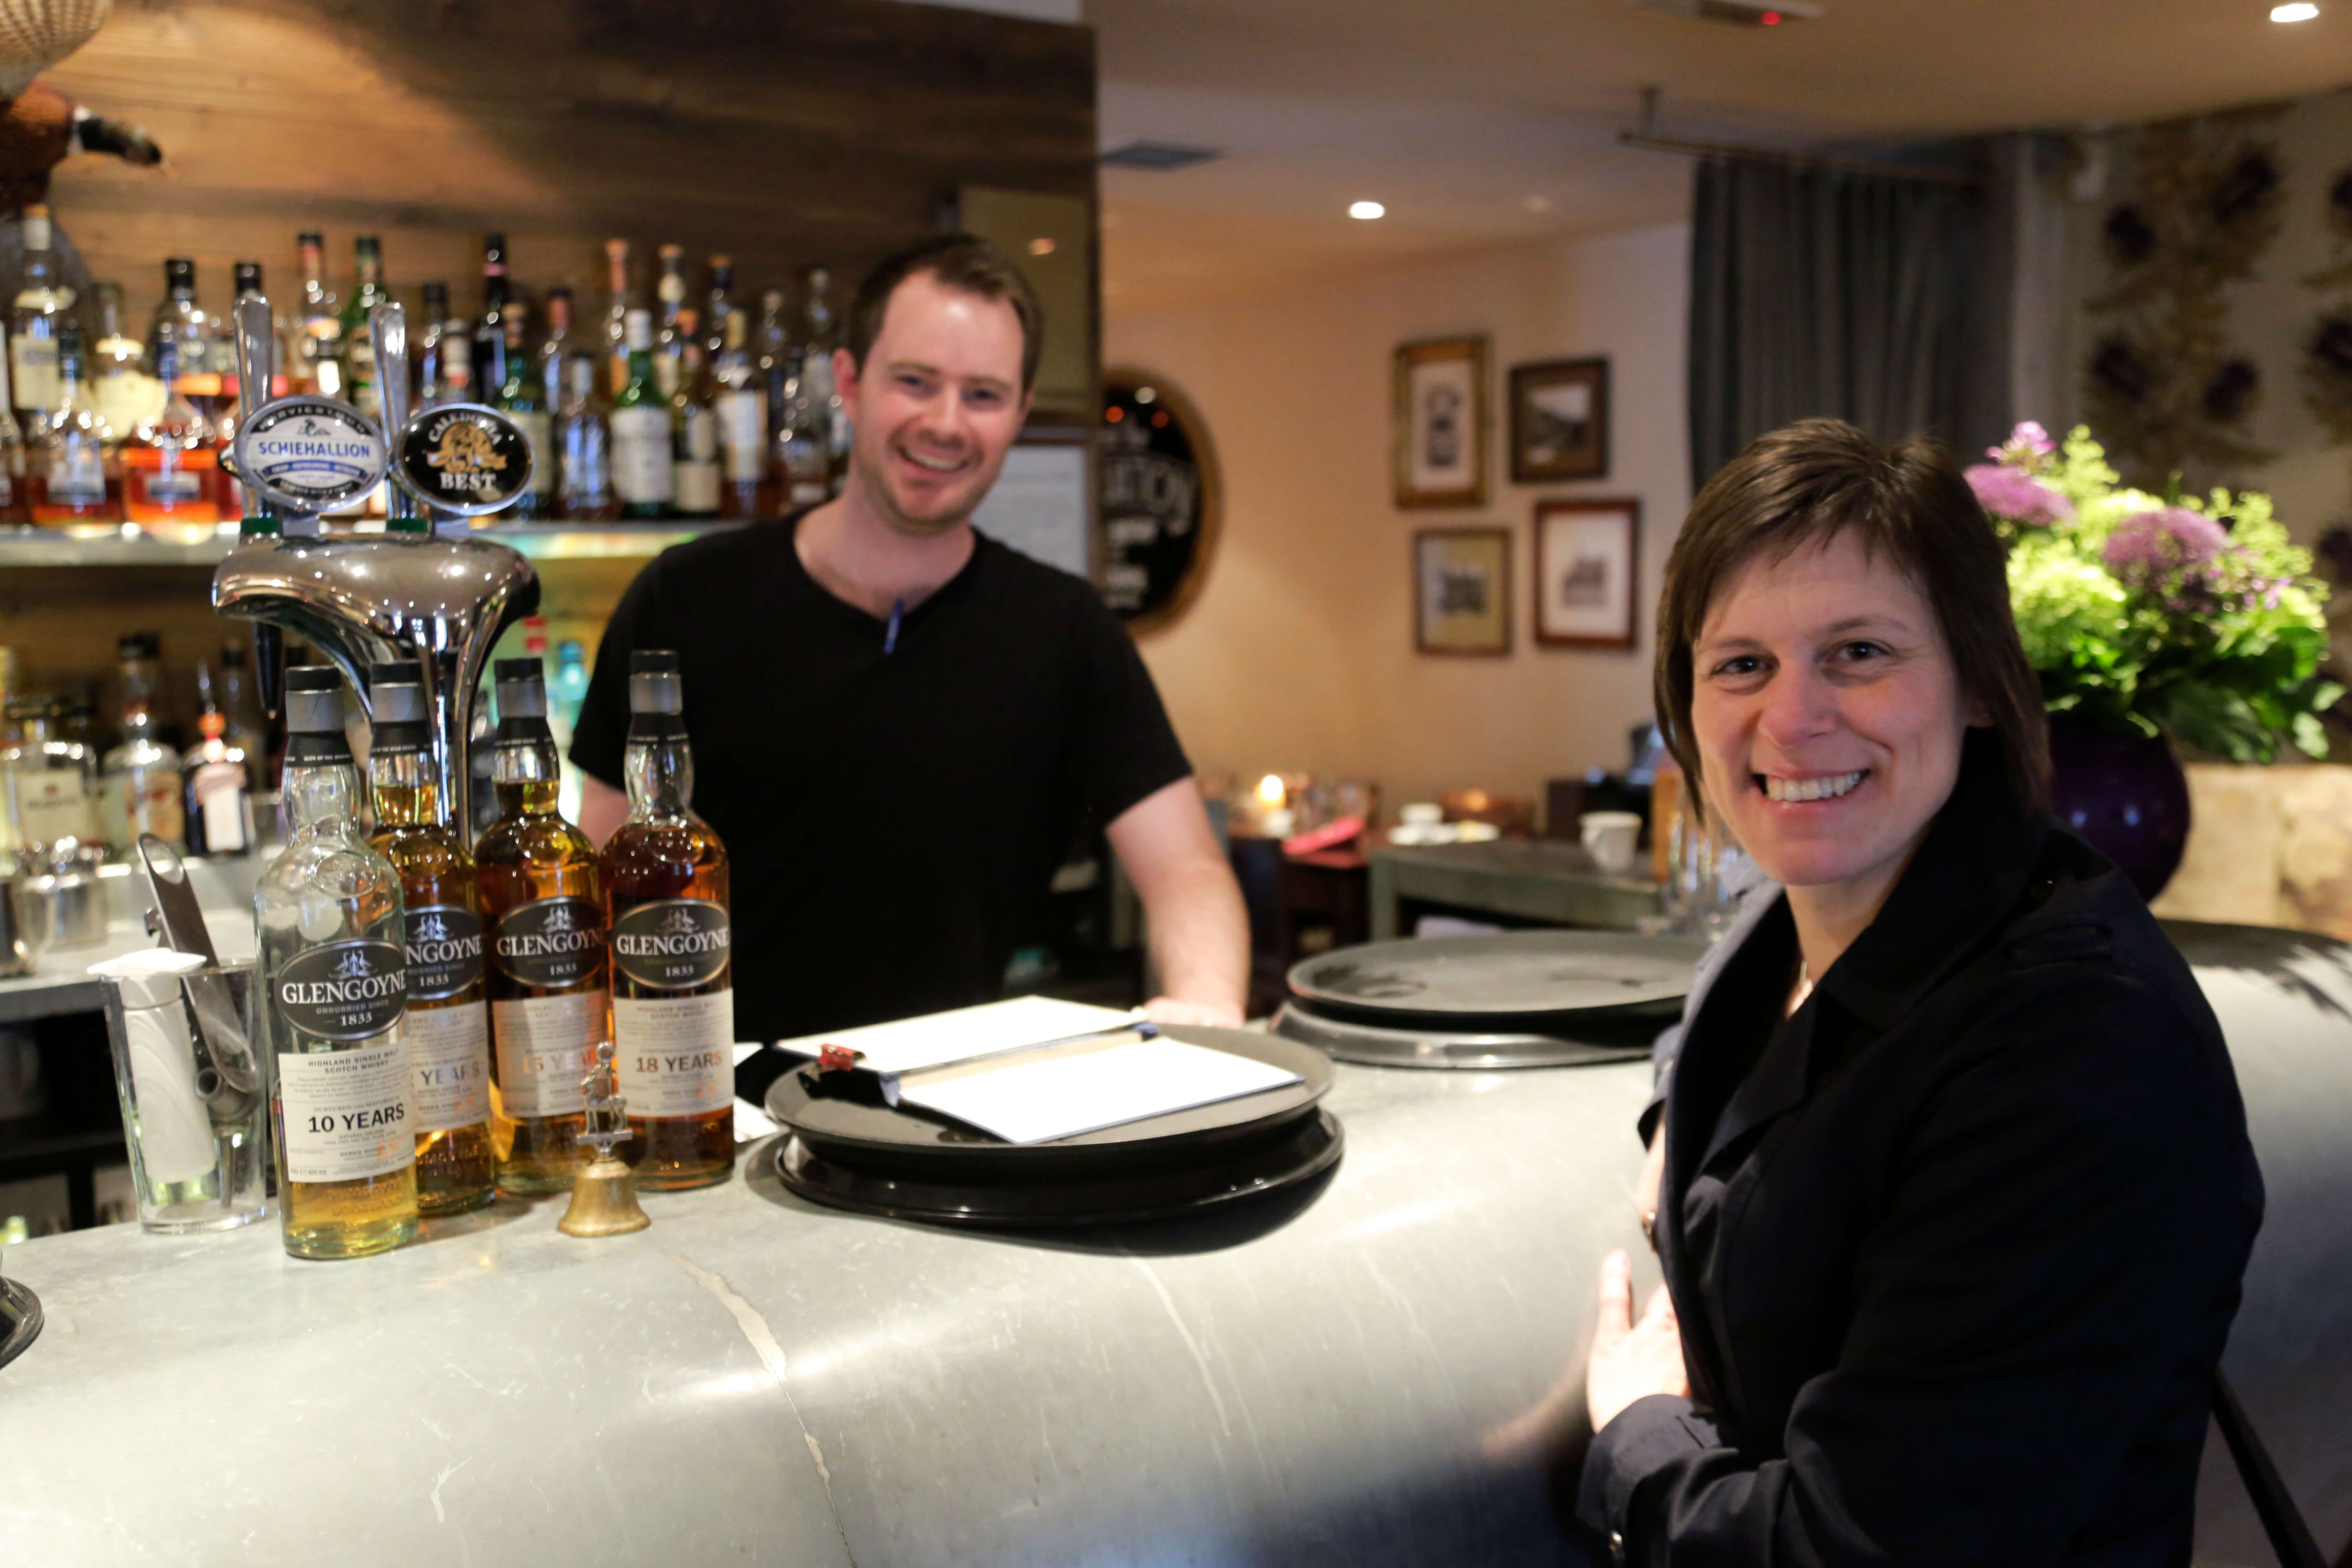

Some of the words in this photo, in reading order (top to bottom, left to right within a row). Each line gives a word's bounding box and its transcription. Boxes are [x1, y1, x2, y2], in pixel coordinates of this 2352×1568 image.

[258, 441, 370, 458] SCHIEHALLION
[440, 472, 496, 490] BEST
[405, 935, 482, 965] NGOYNE
[496, 929, 599, 956] GLENGOYN
[617, 927, 729, 955] GLENGOYNE
[420, 973, 449, 987] 1833
[665, 964, 694, 978] 1833
[282, 969, 406, 1004] GLENGOYNE
[316, 1004, 366, 1015] UNHURRIED
[368, 1000, 389, 1009] SINCE
[341, 1011, 372, 1026] 1833
[308, 1058, 351, 1067] HIGHLAND
[354, 1053, 381, 1063] SINGLE
[384, 1049, 399, 1058] MALT
[361, 1061, 388, 1070] WHISKY
[636, 1056, 658, 1073] 18
[665, 1050, 723, 1072] YEARS
[308, 1116, 334, 1133] 10
[341, 1103, 404, 1130] YEARS
